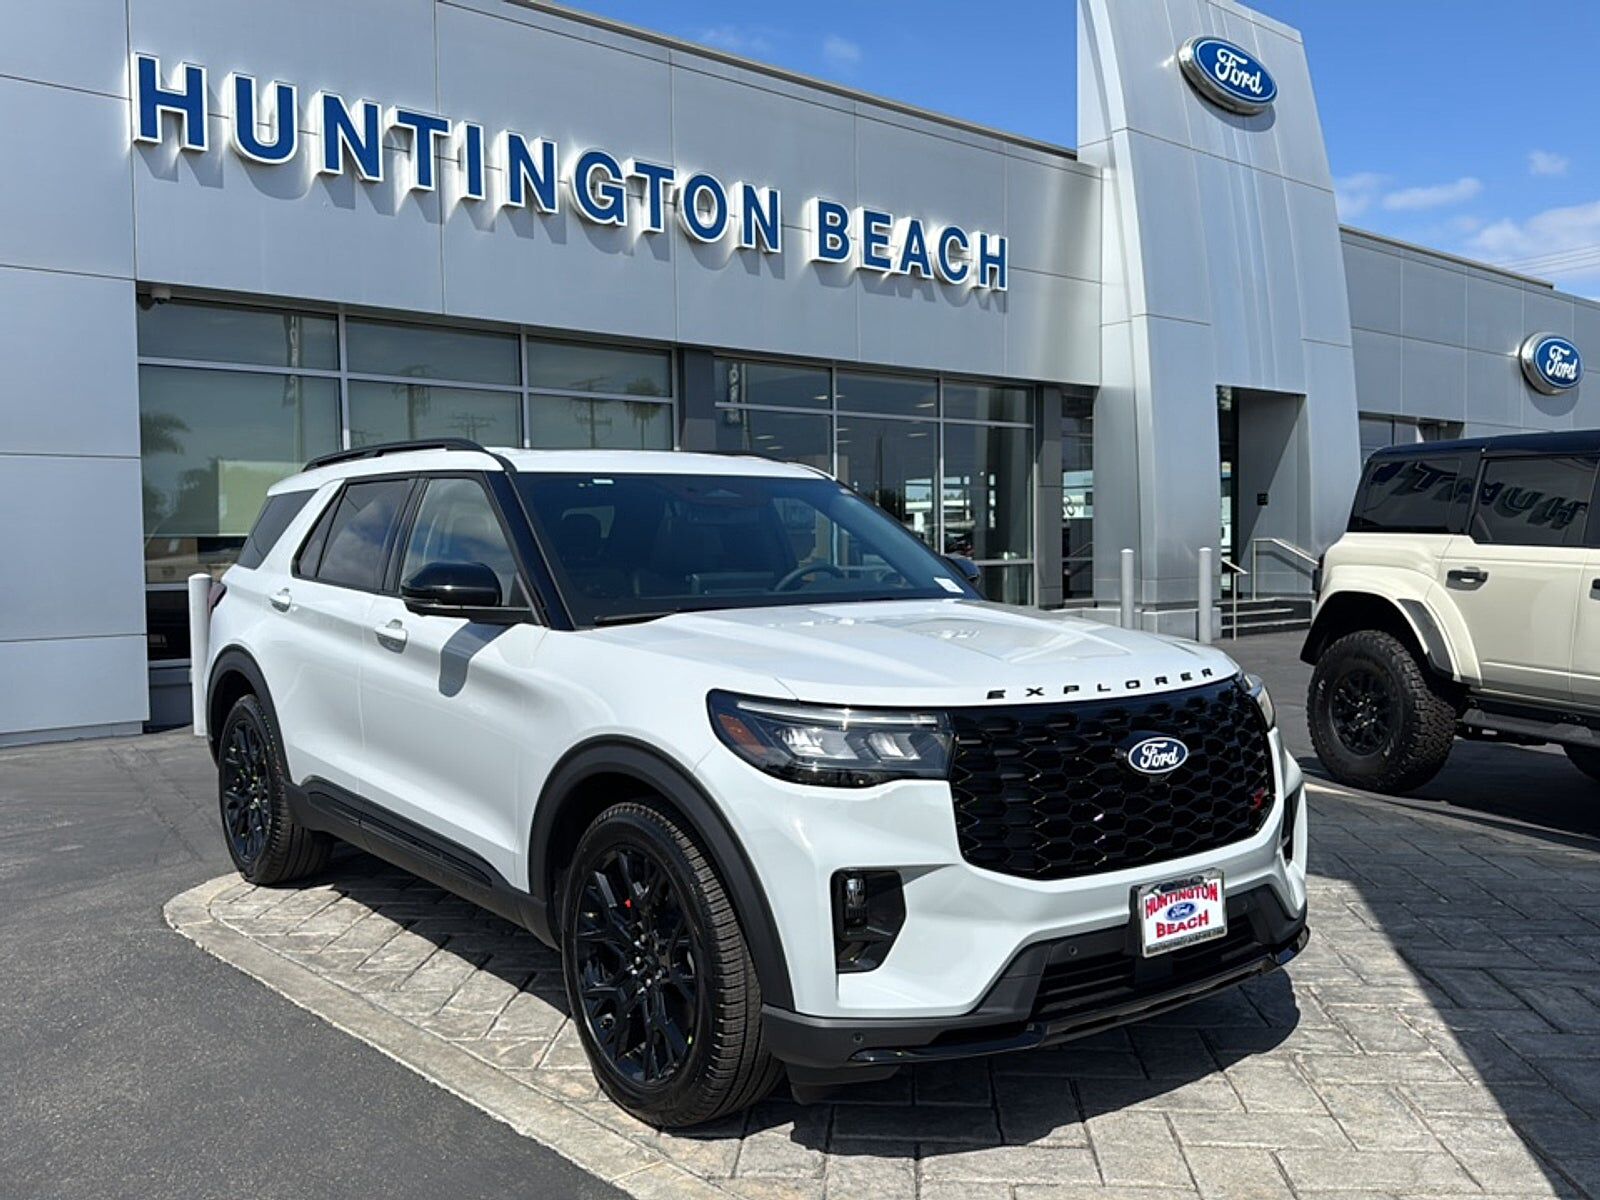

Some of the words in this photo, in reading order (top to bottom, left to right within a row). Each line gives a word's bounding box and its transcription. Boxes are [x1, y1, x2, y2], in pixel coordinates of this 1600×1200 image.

[1215, 48, 1263, 94] Ford
[134, 52, 783, 254] HUNTINGTON
[814, 197, 1009, 291] BEACH
[1546, 345, 1578, 380] Ford
[986, 668, 1213, 700] EXPLORER
[1140, 741, 1180, 768] Ford
[1145, 882, 1218, 919] HUNTINGTON
[1156, 908, 1209, 938] BEACH
